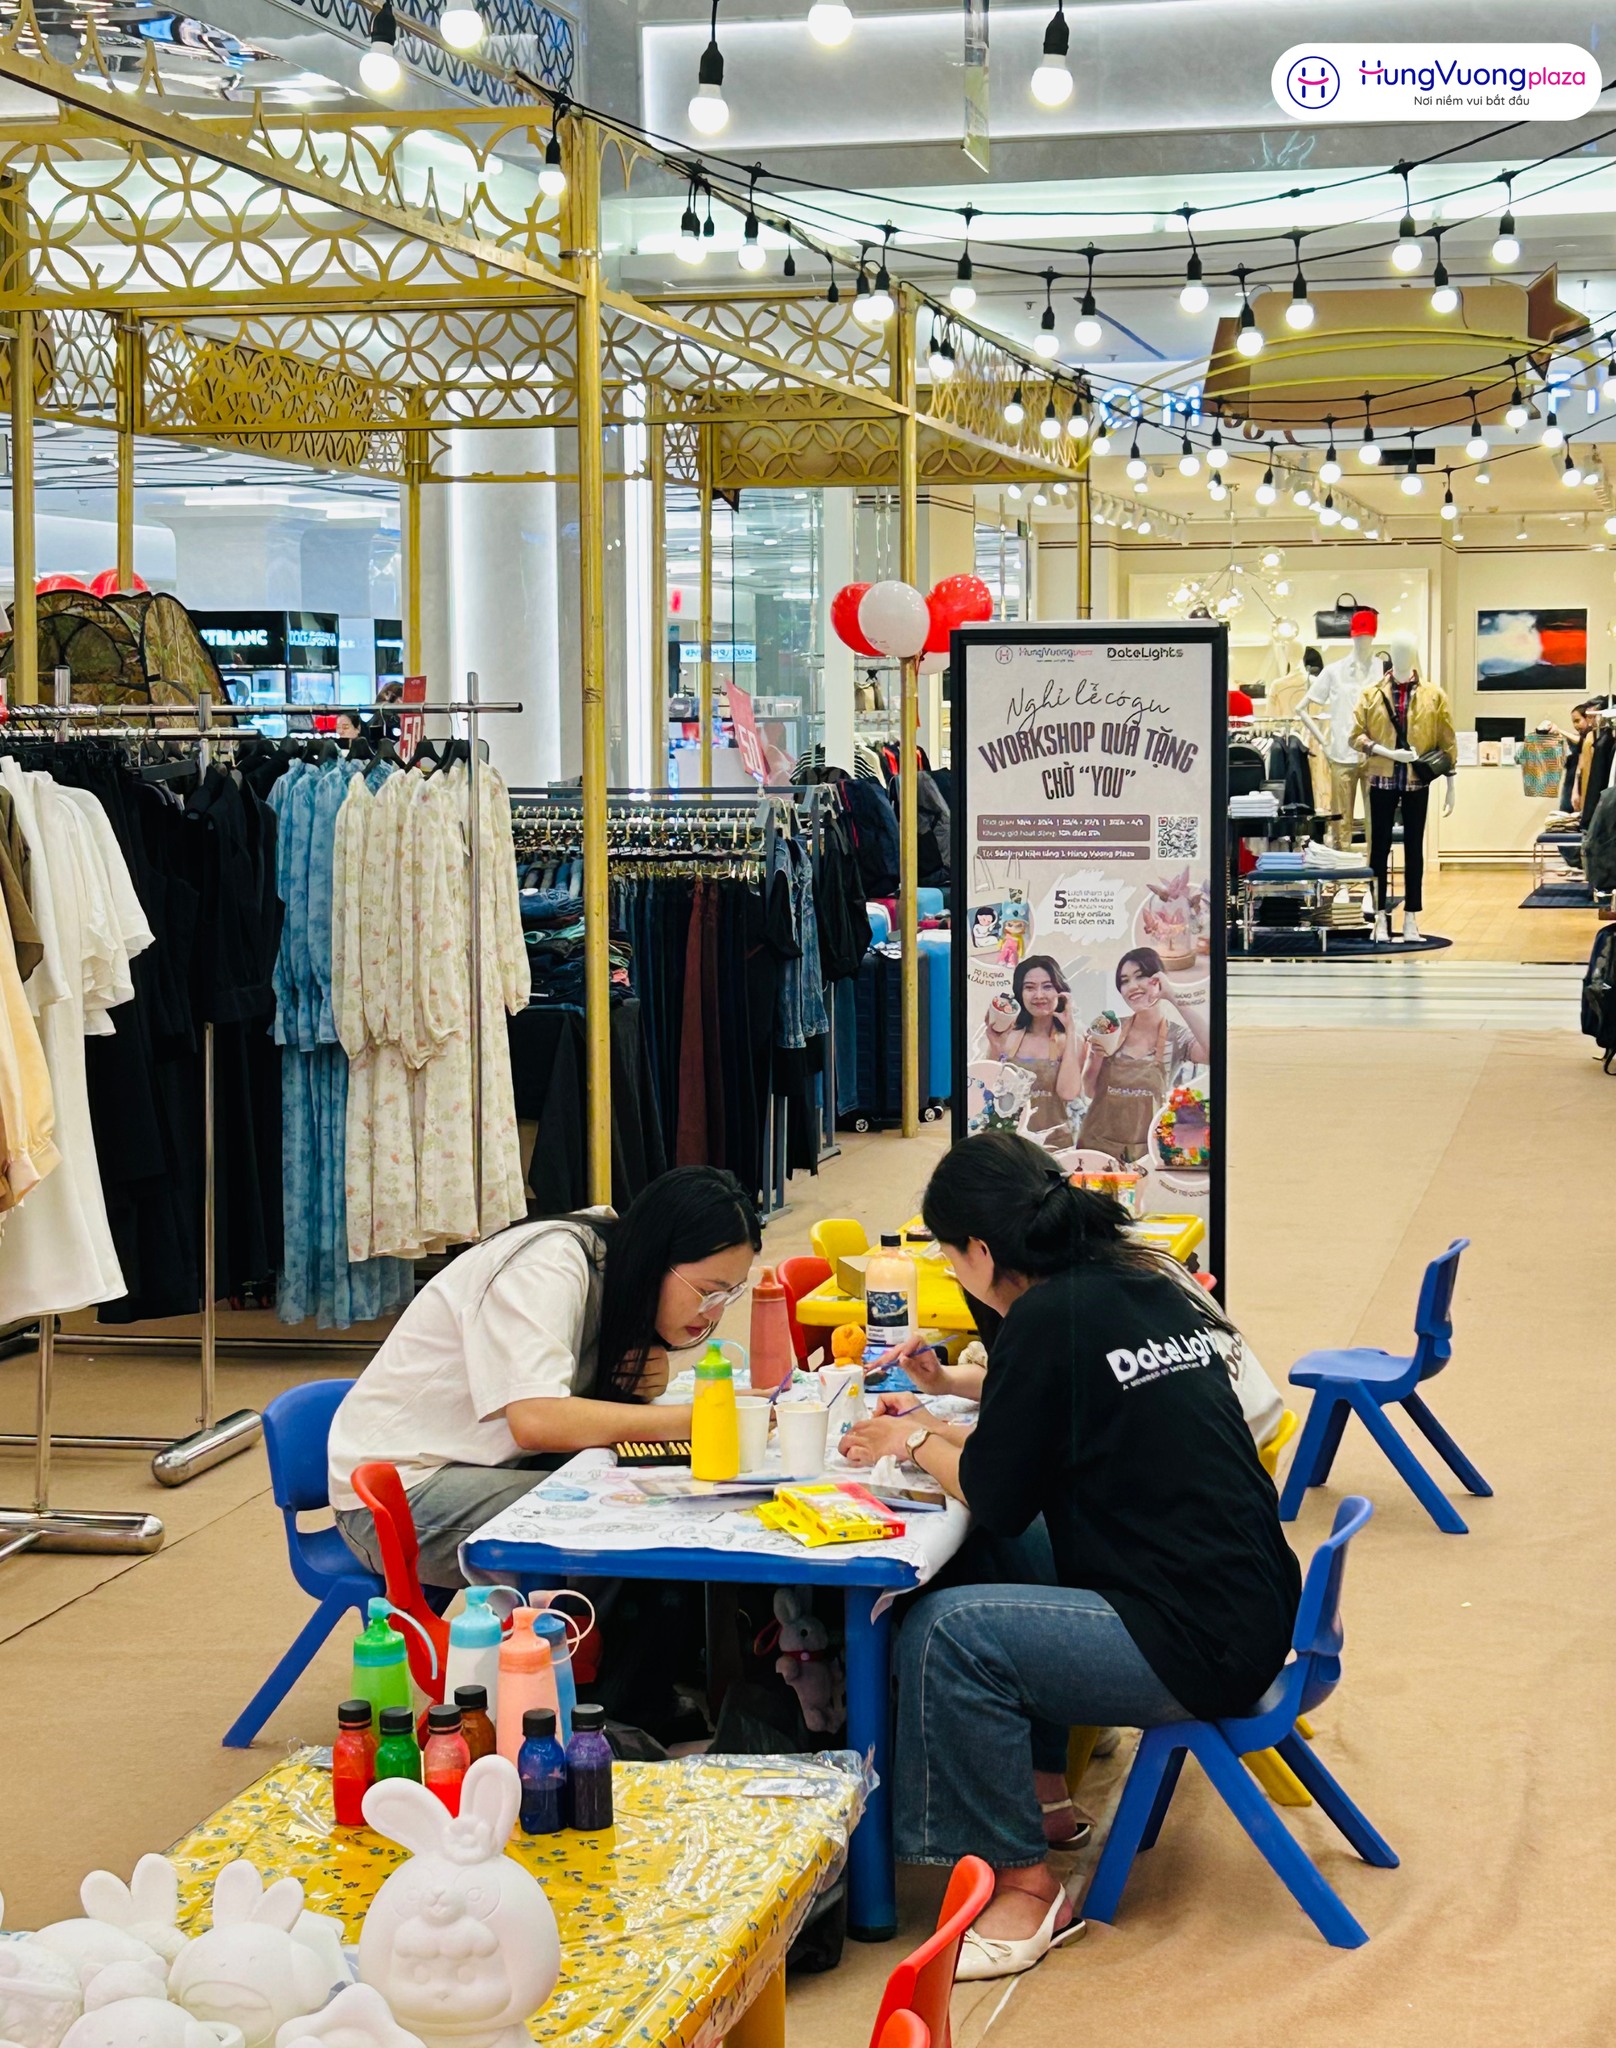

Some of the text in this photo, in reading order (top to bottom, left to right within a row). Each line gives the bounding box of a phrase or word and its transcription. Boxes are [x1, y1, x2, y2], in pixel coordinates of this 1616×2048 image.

[1106, 646, 1184, 661] DateLights
[1075, 678, 1101, 705] lễ
[978, 721, 1096, 774] WORKSHOP
[1144, 725, 1199, 774] TẶNG
[1041, 761, 1074, 800] CHỜ
[1054, 890, 1067, 909] 5
[1105, 1326, 1219, 1382] DateLigh
